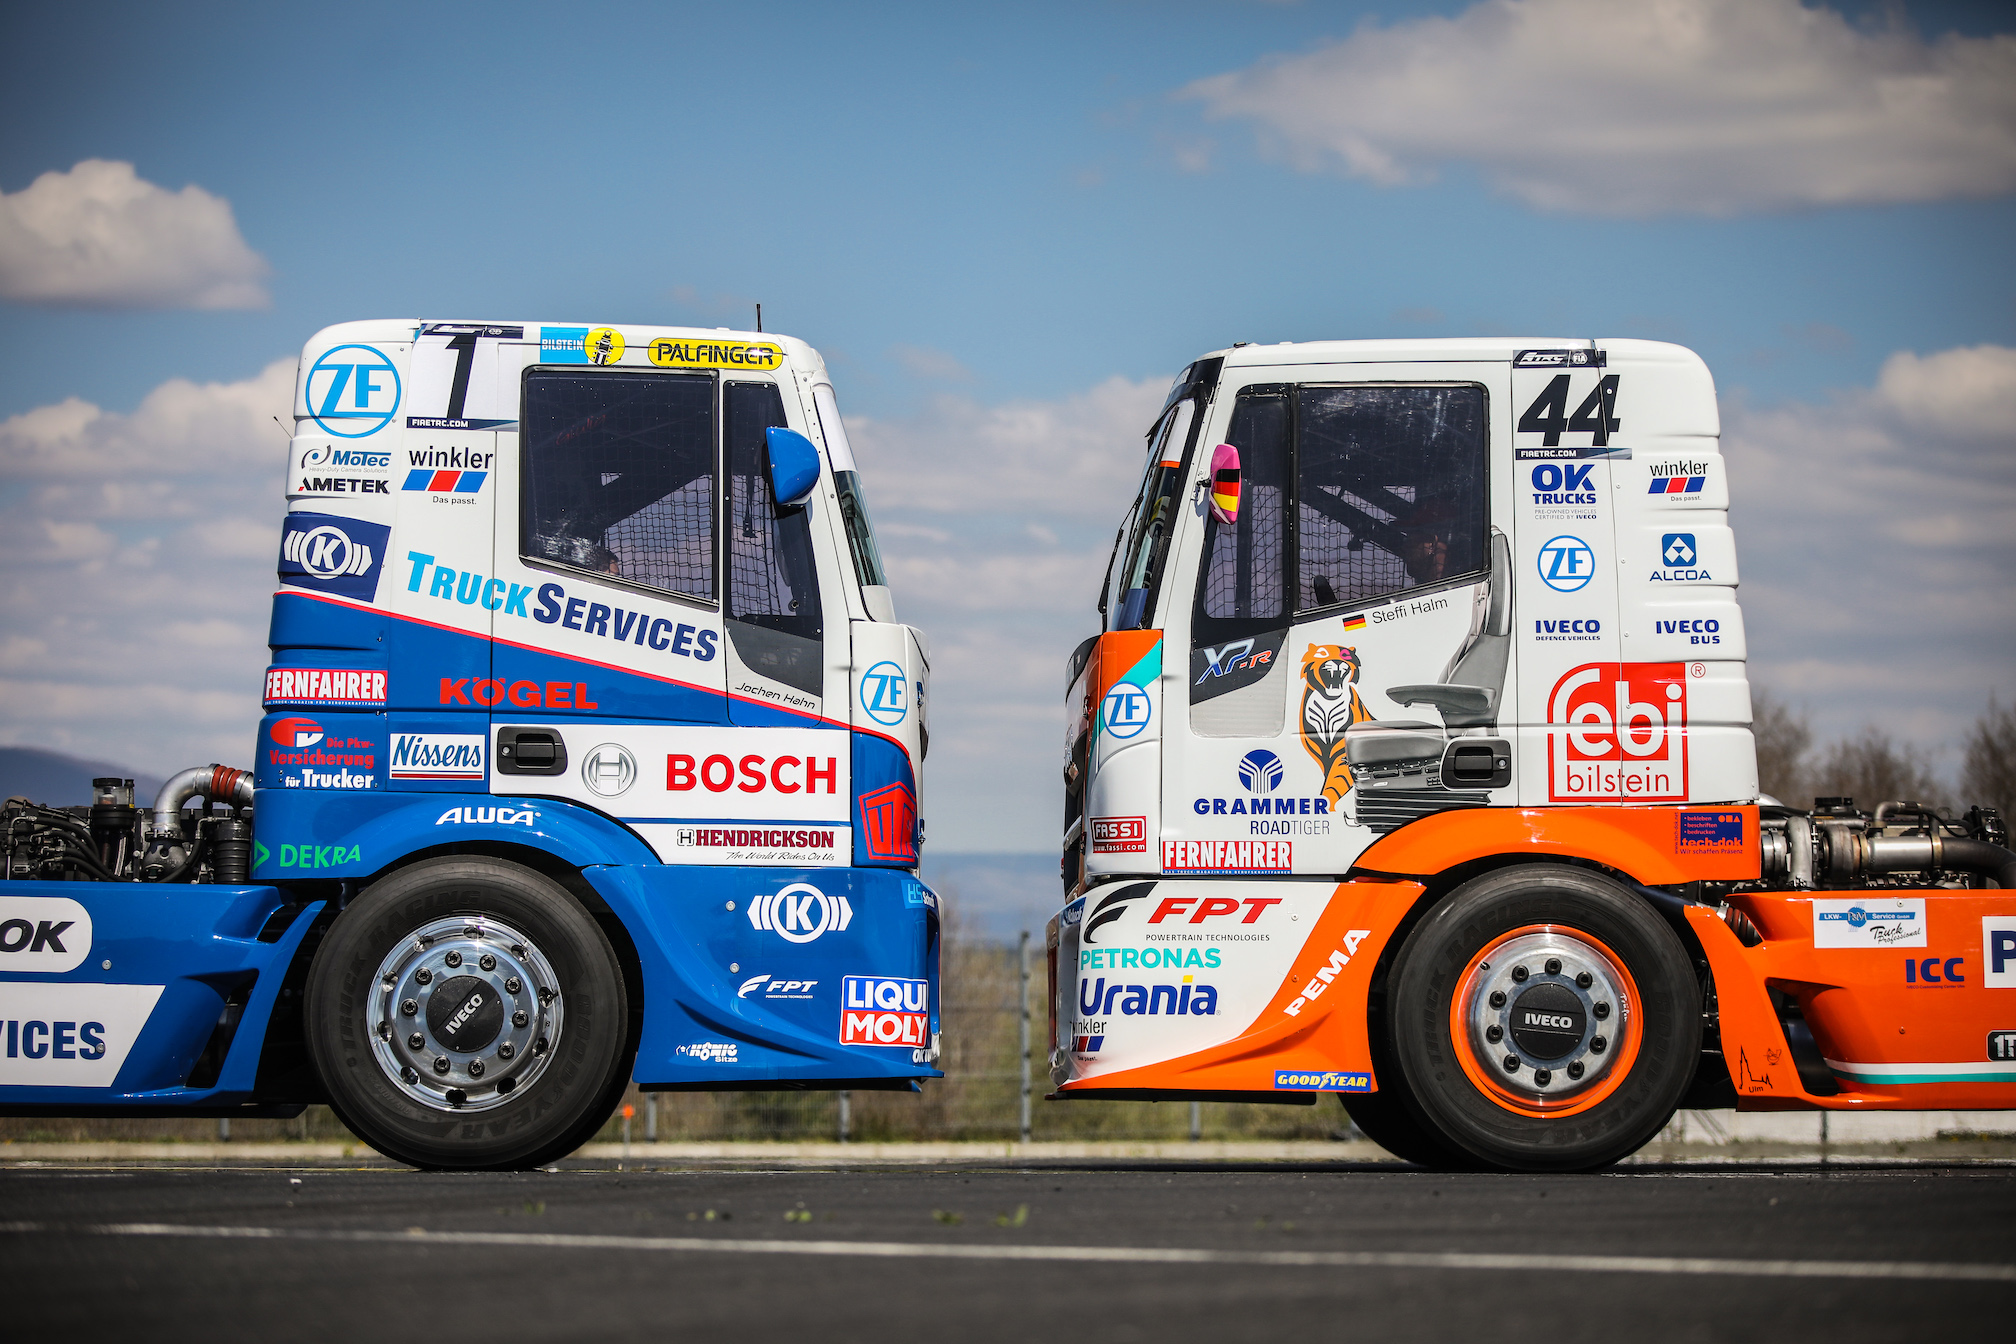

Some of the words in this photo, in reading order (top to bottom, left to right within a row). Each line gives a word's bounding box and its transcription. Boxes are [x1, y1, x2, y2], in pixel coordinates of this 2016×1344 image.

[541, 339, 584, 352] BILSTEIN
[657, 343, 774, 366] PALFINGER
[445, 335, 478, 420] 1
[1517, 374, 1621, 447] 44
[409, 446, 494, 469] winkler
[1649, 460, 1709, 477] winkler
[298, 477, 390, 495] AMETEK
[1531, 464, 1596, 492] OK
[432, 496, 449, 504] Das
[451, 497, 477, 505] passt.
[1532, 493, 1597, 505] TRUCKS
[311, 535, 342, 571] K
[1649, 570, 1712, 581] ALCOA
[1372, 607, 1408, 625] Steffi
[1410, 596, 1449, 616] Halm
[1536, 619, 1601, 634] IVECO
[1656, 619, 1720, 634] IVECO
[1690, 635, 1721, 645] BUS
[265, 671, 386, 700] FERNFAHRER
[440, 676, 599, 710] KÖGEL
[735, 683, 781, 701] Jochen
[783, 693, 816, 710] Hahn
[1553, 667, 1684, 760] febi
[327, 737, 345, 748] Die
[347, 737, 375, 749] Pkw-
[392, 736, 482, 768] Nissens
[270, 748, 375, 770] Versicherung
[285, 776, 302, 788] für
[302, 768, 375, 789] Trucker
[667, 754, 838, 794] BOSCH
[1567, 764, 1670, 792] bilstein
[435, 807, 535, 826] ALUCA
[1194, 798, 1330, 815] GRAMMER
[696, 829, 835, 848] HENDRICKSON
[1095, 823, 1139, 838] FASSI
[1250, 821, 1331, 836] ROADTIGER
[1682, 837, 1742, 847] tech-dok
[280, 844, 361, 868] DEKRA
[726, 851, 744, 861] The
[745, 851, 774, 861] World
[779, 852, 806, 861] Rides
[808, 852, 821, 861] On
[822, 853, 835, 861] Us
[1164, 841, 1291, 868] FERNFAHRER
[786, 895, 816, 931] K
[1147, 898, 1284, 924] FPT
[1146, 934, 1203, 942] POWERTRAIN
[1205, 934, 1270, 942] TECHNOLOGIES
[1869, 922, 1903, 940] Truck
[1878, 927, 1921, 945] Professional
[1080, 948, 1222, 970] PETRONAS
[1905, 957, 1965, 983] ICC
[1283, 930, 1372, 1017] PEMA
[766, 980, 818, 993] FPT
[848, 979, 928, 1012] LIQUI
[1080, 975, 1219, 1016] Urania
[445, 993, 484, 1035] IVECO
[1525, 1013, 1573, 1030] IVECO
[846, 1012, 927, 1045] MOLY
